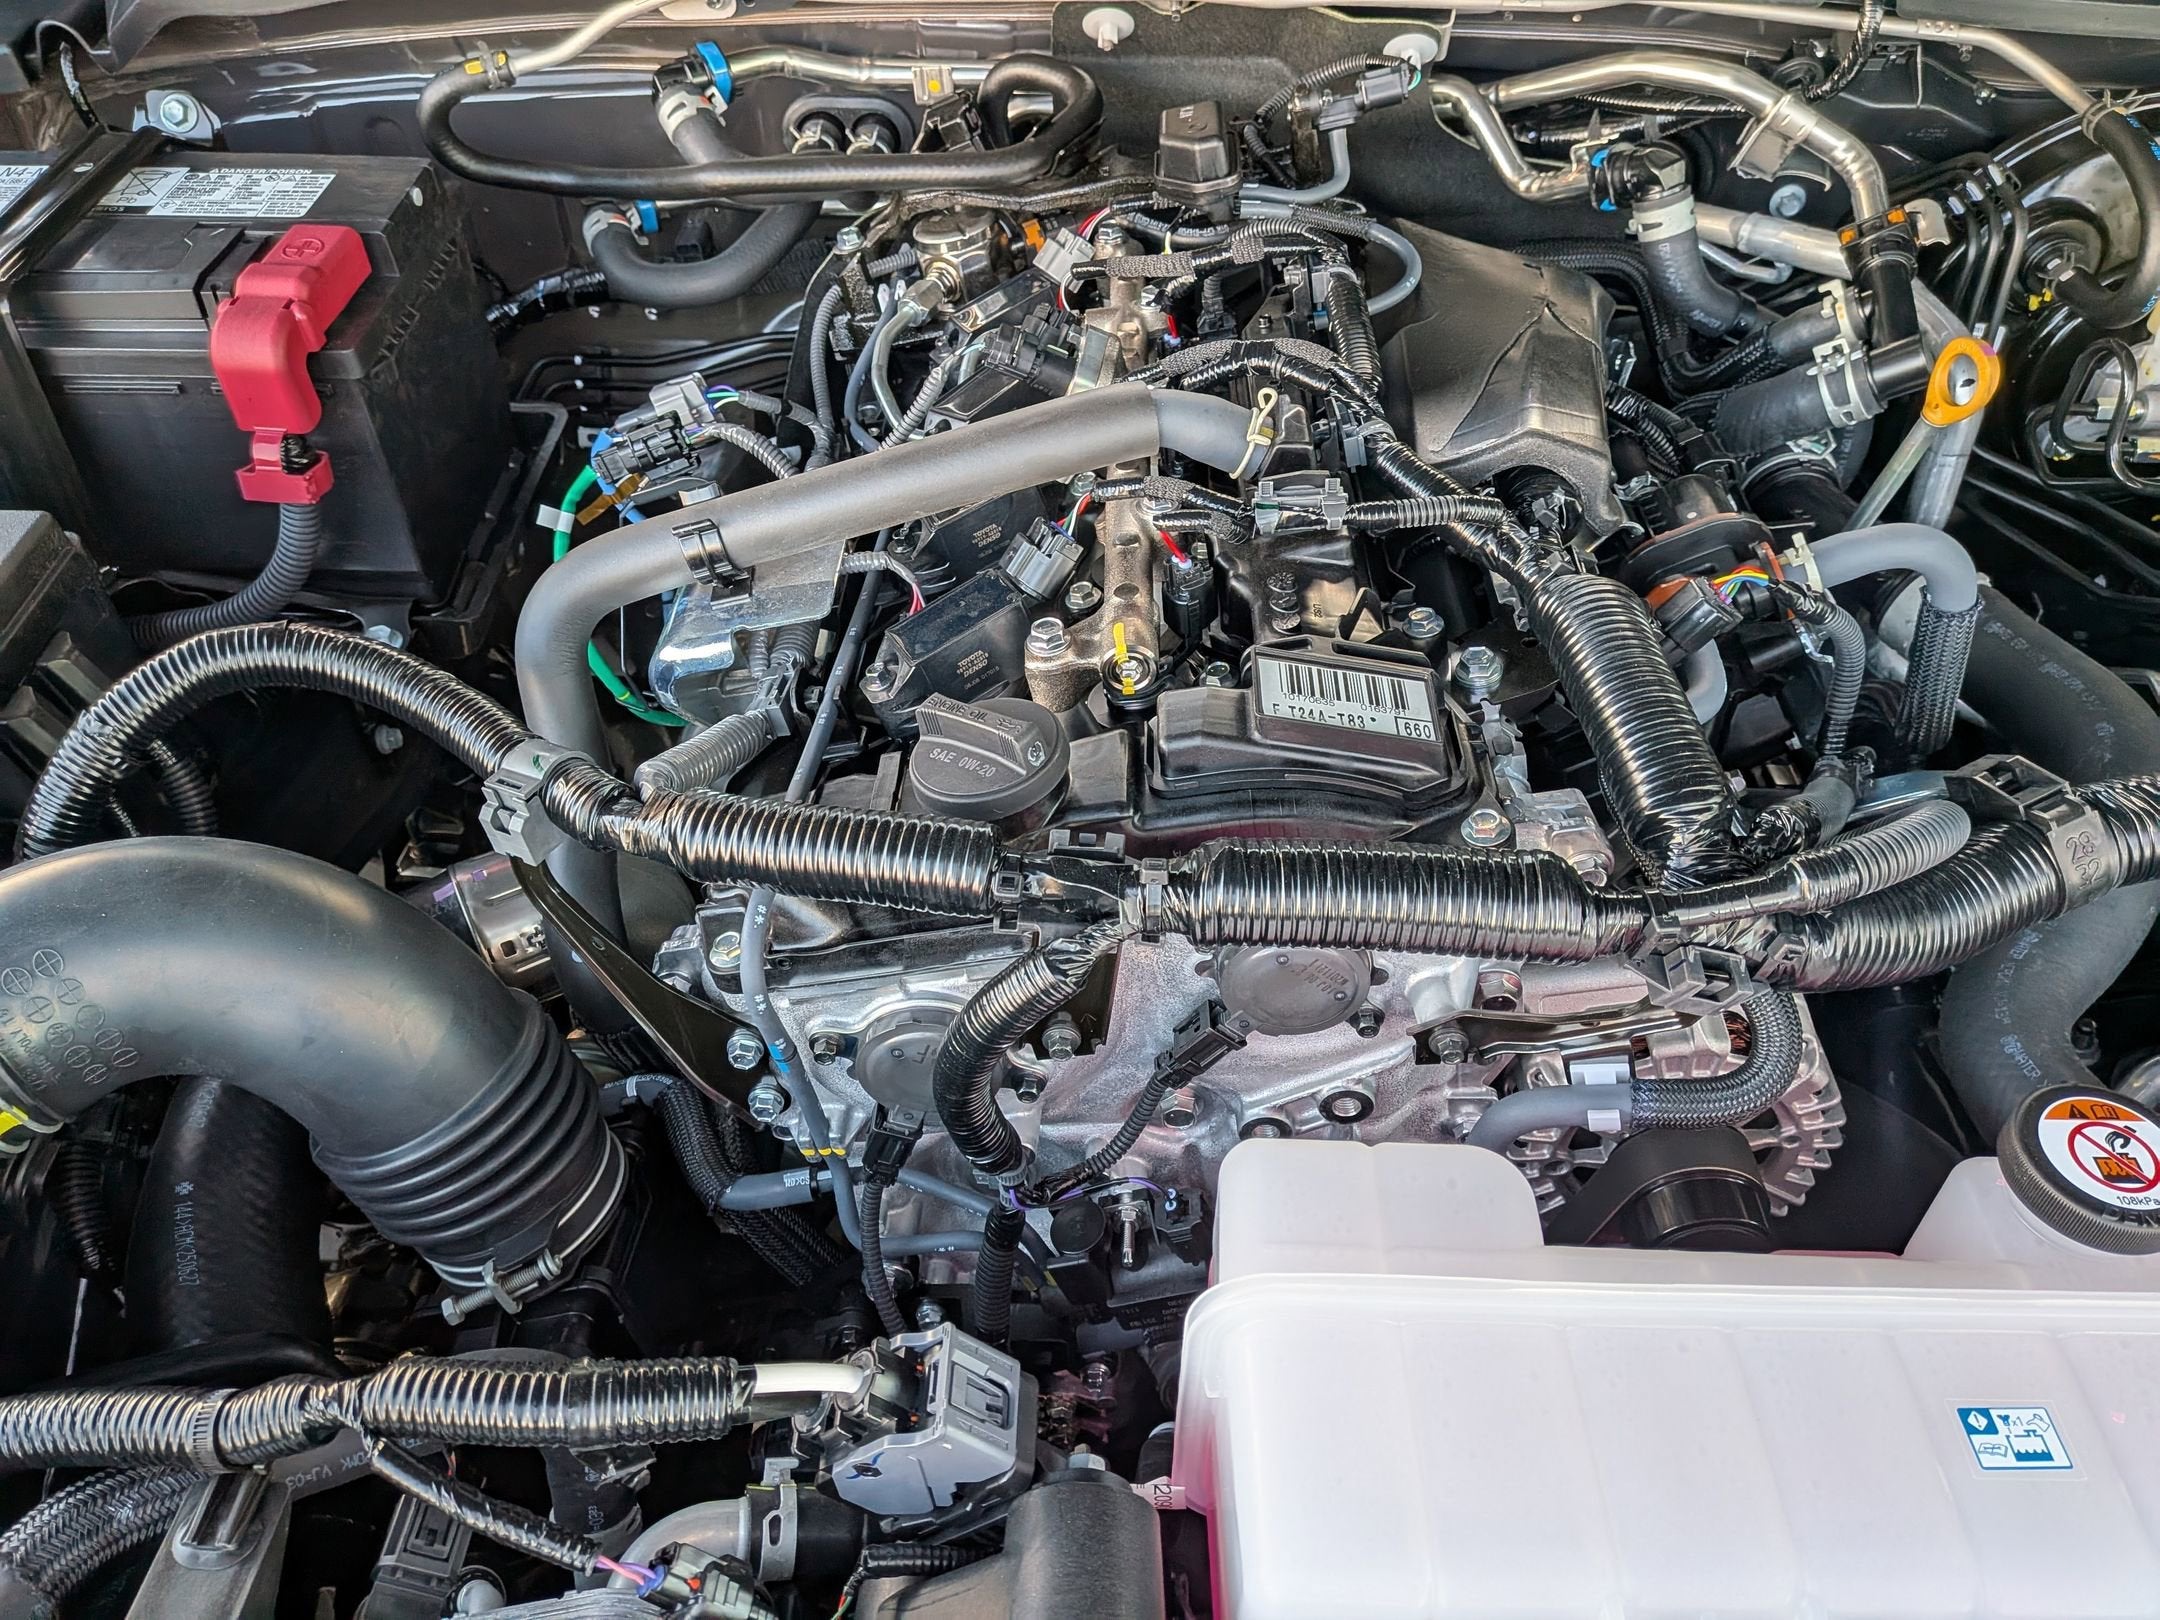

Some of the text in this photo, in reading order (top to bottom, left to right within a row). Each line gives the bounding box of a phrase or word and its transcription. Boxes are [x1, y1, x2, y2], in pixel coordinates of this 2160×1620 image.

[117, 196, 138, 204] Pb
[972, 523, 998, 538] TOYOTA
[978, 532, 1001, 548] DENSO
[957, 650, 984, 667] TOYOTA
[963, 659, 988, 678] DENSO
[927, 697, 989, 723] ENGINE OIL
[1272, 702, 1280, 715] F
[1360, 703, 1408, 717] 0163791
[1404, 721, 1432, 739] 660
[929, 747, 997, 778] SAE 0W-20
[2065, 830, 2096, 865] 28
